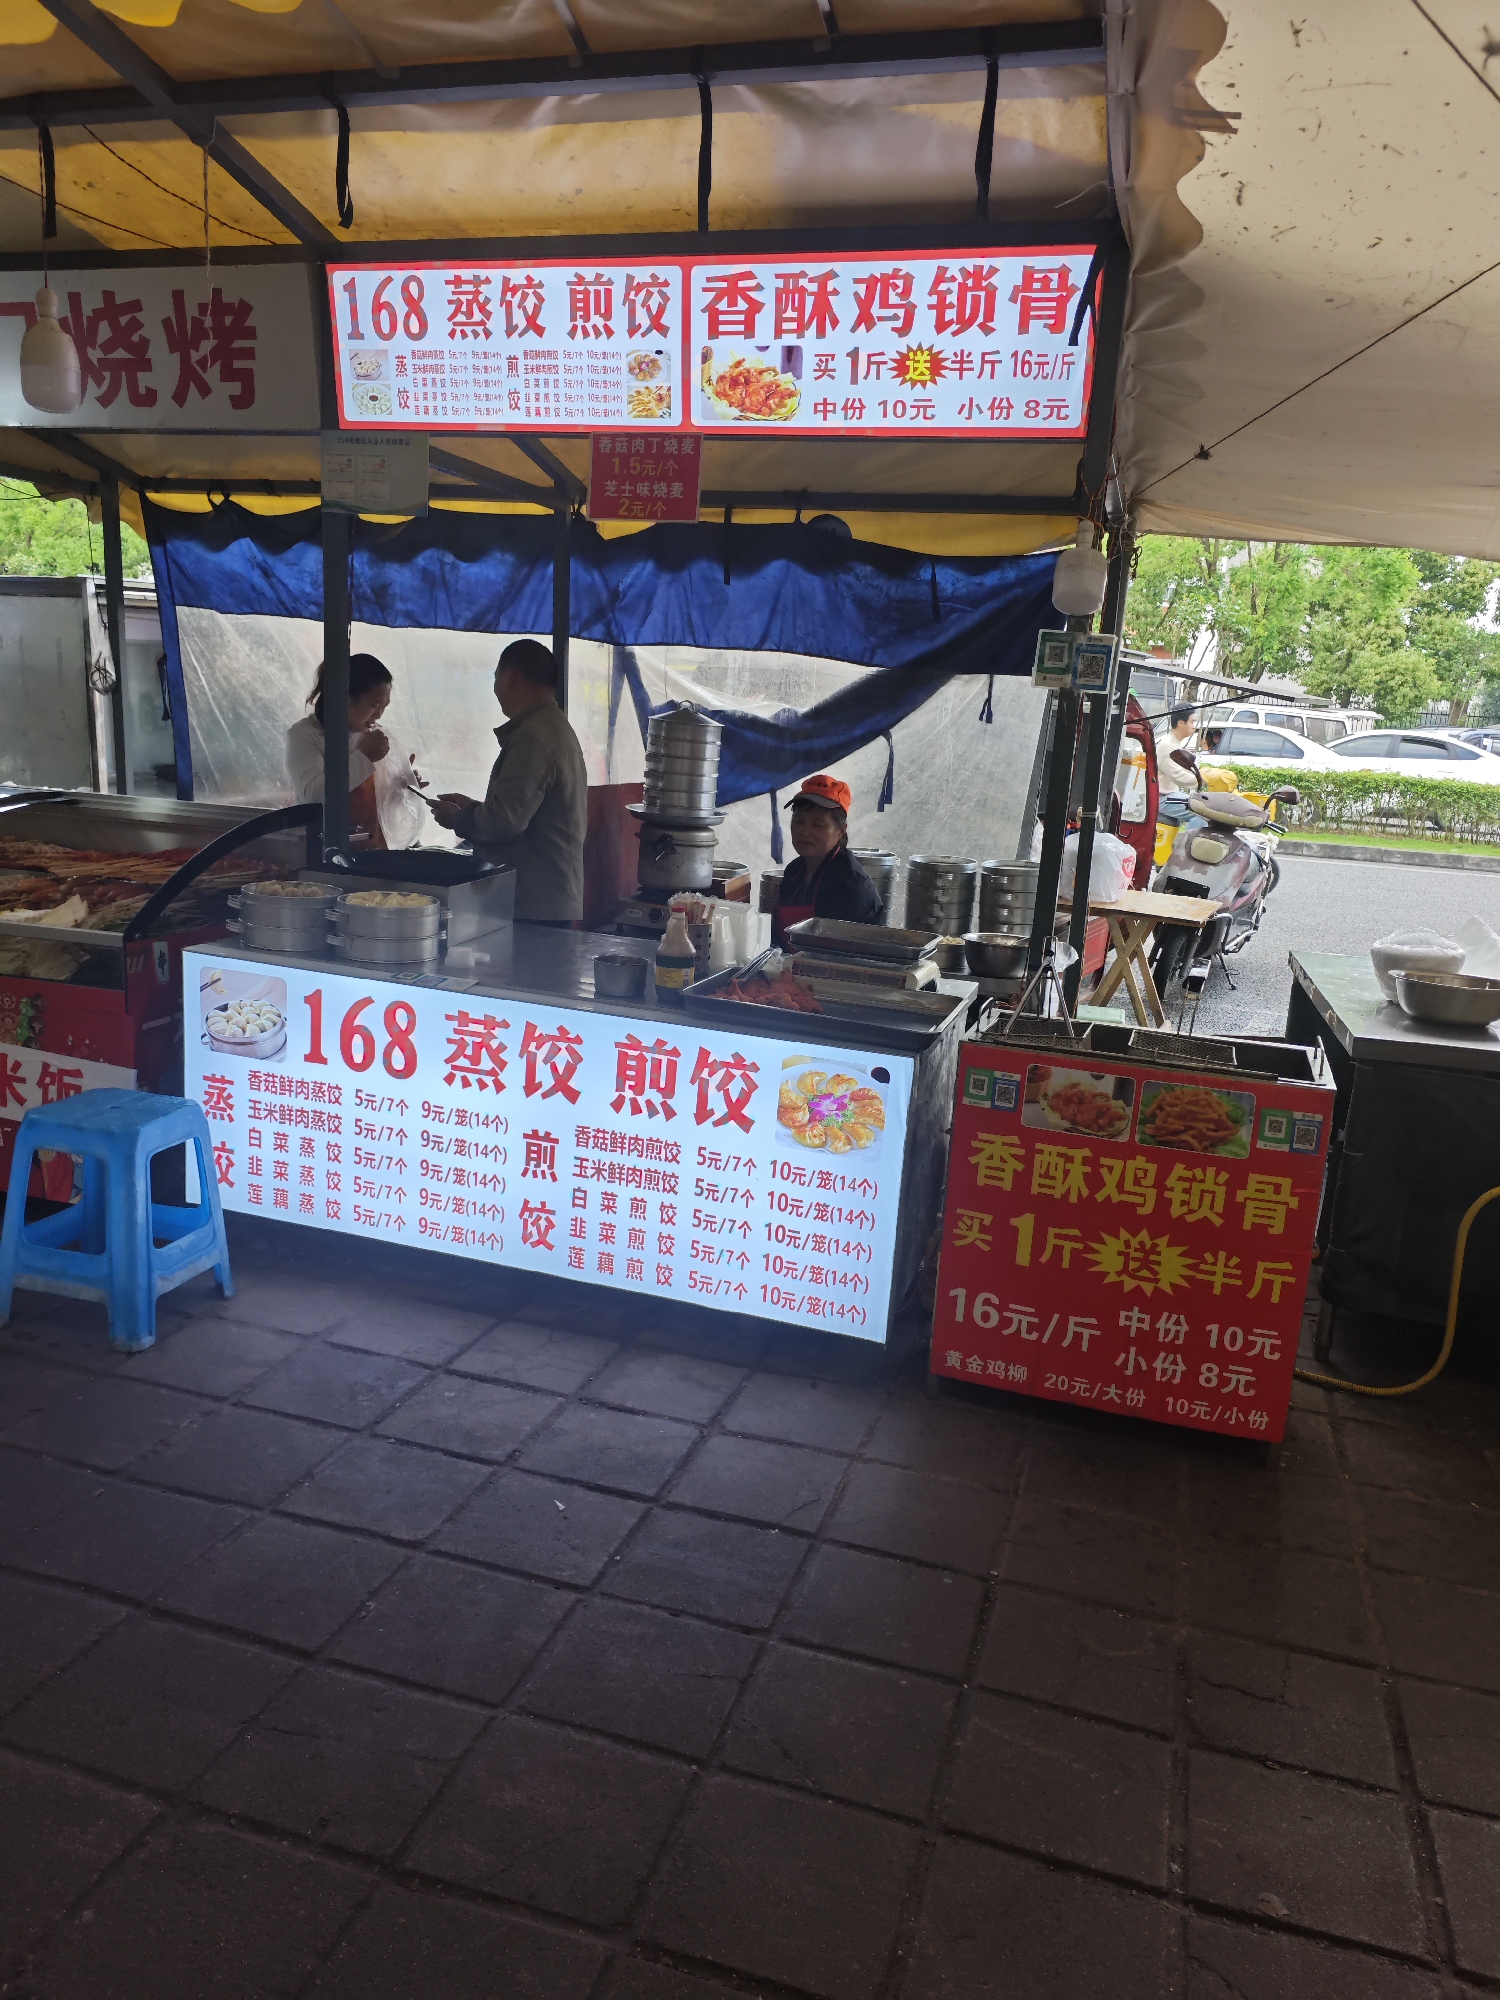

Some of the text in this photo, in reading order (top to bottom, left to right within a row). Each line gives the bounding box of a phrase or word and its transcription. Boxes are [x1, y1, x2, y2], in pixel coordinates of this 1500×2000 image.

[342, 271, 671, 341] 168 蒸饺 煎饺
[700, 262, 1081, 341] 香酥鸡锁骨
[0, 288, 257, 410] 烧烤
[1010, 348, 1075, 380] 16元/斤
[395, 354, 410, 411] 蒸饺
[505, 354, 521, 411] 煎饺
[598, 436, 695, 454] 香菇肉丁烧麦
[611, 456, 678, 476] 1.5元/个
[604, 479, 684, 498] 芝士味烧麦
[618, 497, 667, 518] 2元/个
[303, 988, 761, 1134] 168 蒸饺 煎饺
[248, 1069, 509, 1135] 香菇鲜肉蒸饺 5元/7个 9元/笼(14个)
[248, 1099, 508, 1165] 玉米鲜肉蒸饺 5元/7个 9元/笼(14个)
[353, 1147, 408, 1175] 5元/7个
[420, 1159, 507, 1194] 9元/笼(14个)
[518, 1128, 560, 1251] 煎饺
[574, 1124, 879, 1199] 香菇鲜肉煎饺 5元/7个 10元/笼(14个)
[968, 1131, 1299, 1236] 香酥鸡锁骨
[353, 1176, 407, 1204] 5元/7个
[419, 1188, 505, 1223] 9元/笼(14个)
[572, 1155, 876, 1231] 玉米鲜肉煎饺 5元/7个 10元/笼(14个)
[353, 1205, 406, 1233] 5元/7个
[418, 1216, 504, 1252] 9元/笼(14个)
[691, 1209, 753, 1241] 5元/7个
[764, 1222, 873, 1263] 10元/笼(14个)
[689, 1239, 750, 1272] 5元/7个
[762, 1253, 869, 1294] 10元/笼(14个)
[687, 1270, 748, 1302] 5元/7个
[759, 1284, 866, 1325] 10元/笼(14个)
[949, 1286, 1101, 1353] 16元/斤
[1118, 1305, 1282, 1361] 中份 10元
[944, 1349, 1269, 1431] 黄金鸡柳 20元/大份 10元/小份
[1114, 1346, 1256, 1398] 小份 8元
